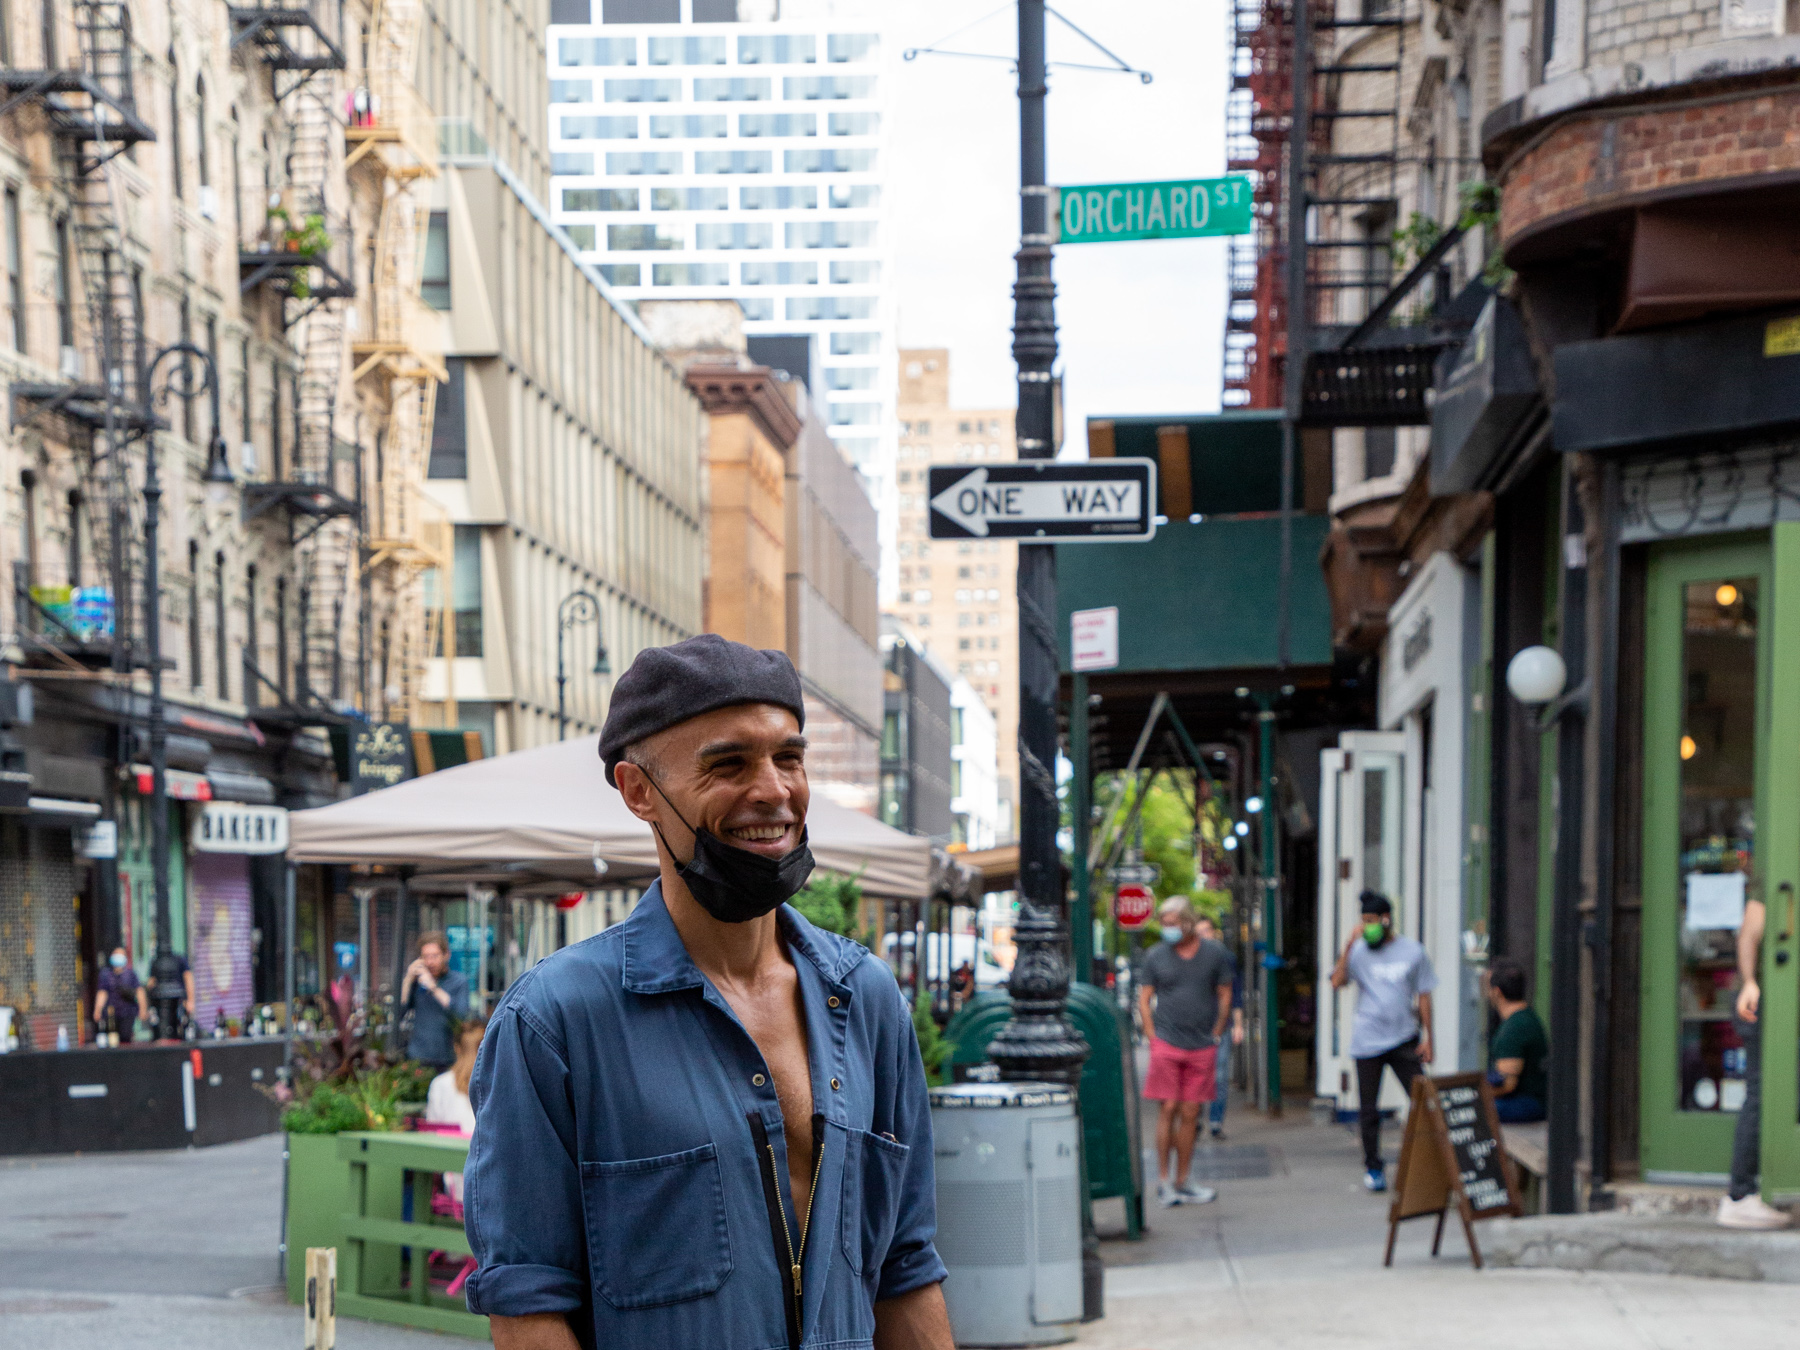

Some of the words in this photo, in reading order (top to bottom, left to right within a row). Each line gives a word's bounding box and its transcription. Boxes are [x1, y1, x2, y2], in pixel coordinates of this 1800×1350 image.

[1064, 185, 1210, 236] ORCHARD
[1215, 182, 1243, 206] ST
[957, 487, 1022, 516] ONE
[1062, 485, 1131, 514] WAY
[358, 759, 404, 785] fringe
[203, 814, 279, 843] BAKERY
[1114, 895, 1152, 918] STOP
